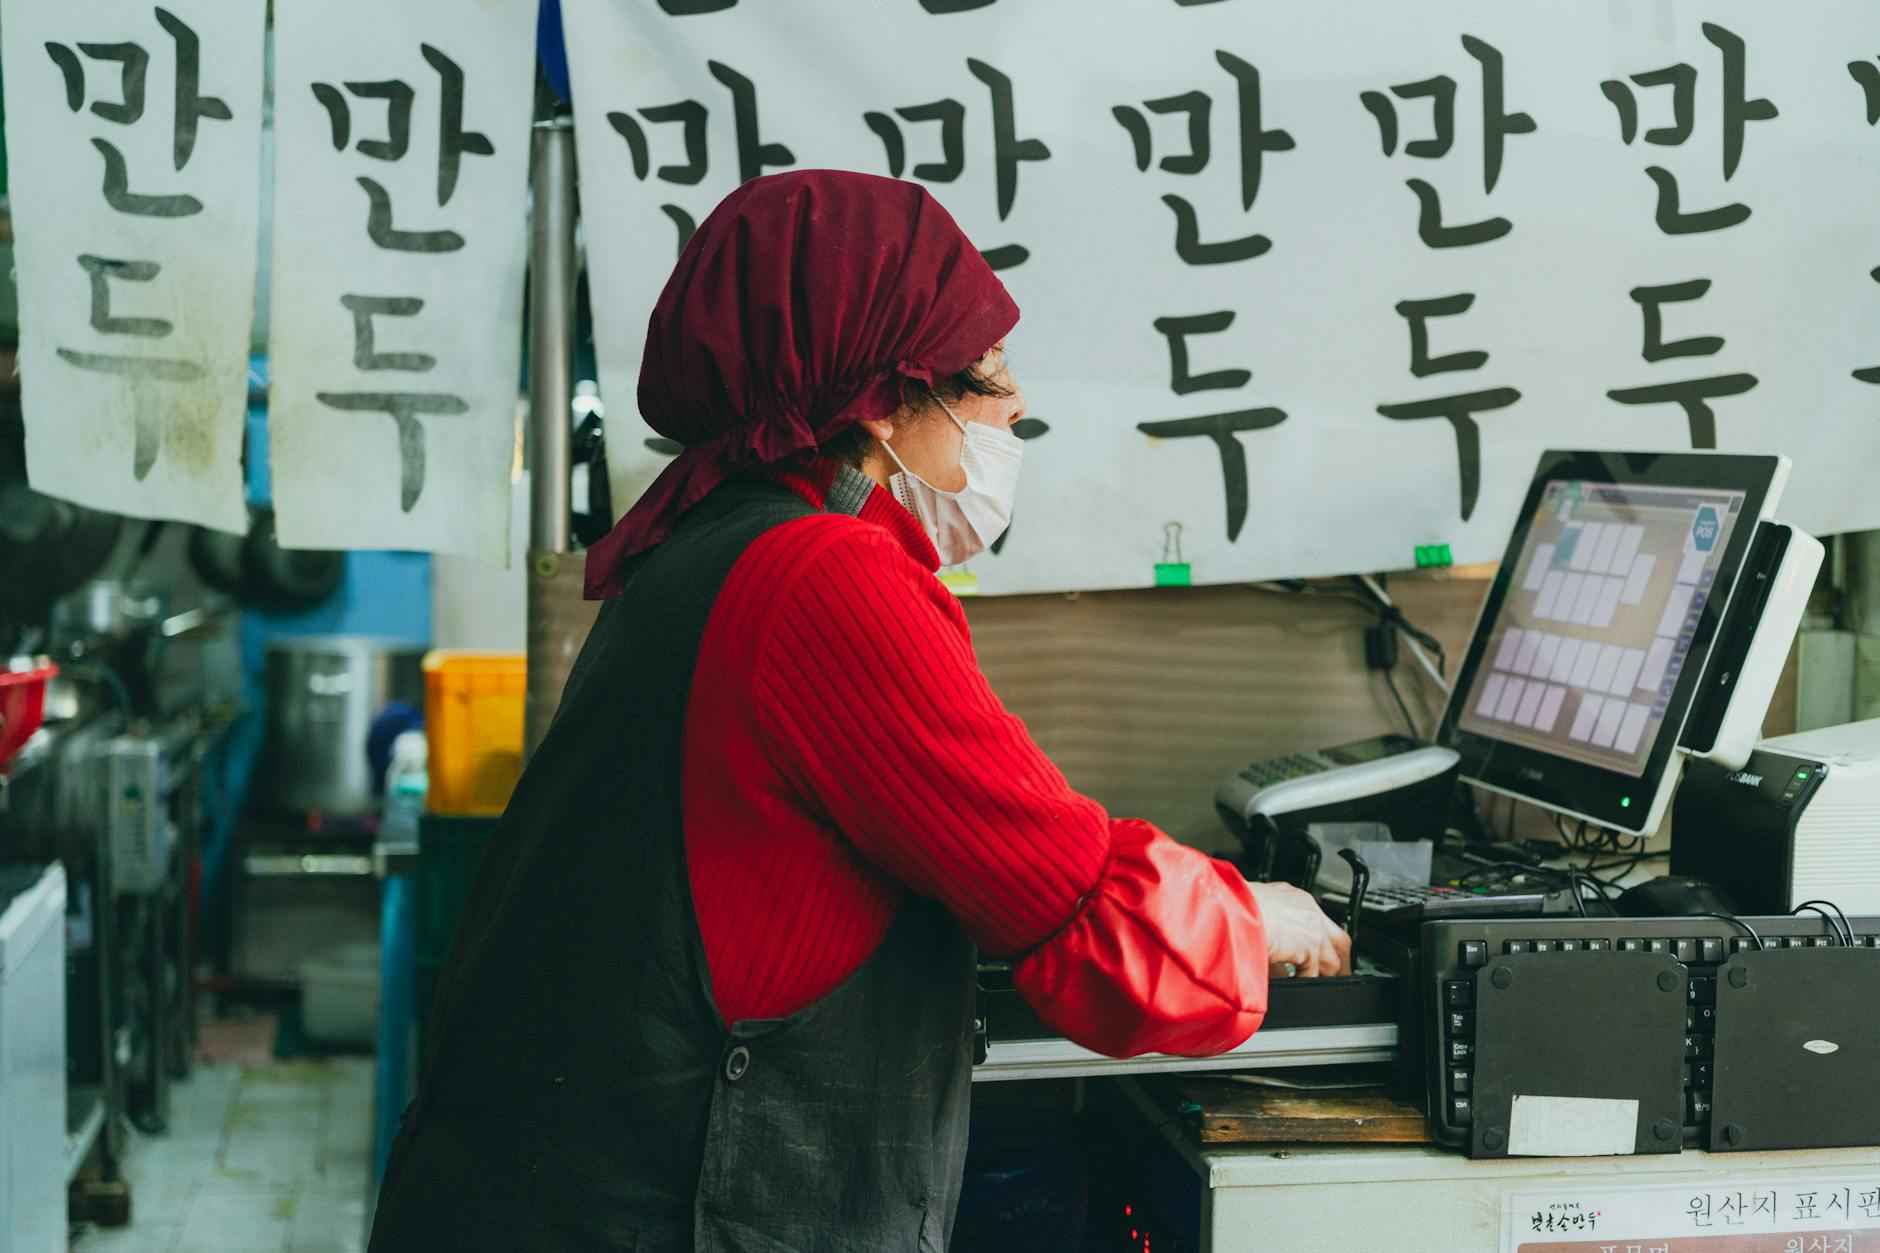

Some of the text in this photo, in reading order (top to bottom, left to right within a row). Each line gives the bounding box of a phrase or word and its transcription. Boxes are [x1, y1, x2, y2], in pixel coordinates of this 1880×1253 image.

[44, 5, 233, 482] 만두
[311, 43, 495, 513] 만두
[1111, 50, 1296, 543] 만두
[1359, 34, 1537, 522] 만두
[1600, 22, 1779, 448] 만두
[1686, 1186, 1880, 1227] 원산지 표시판
